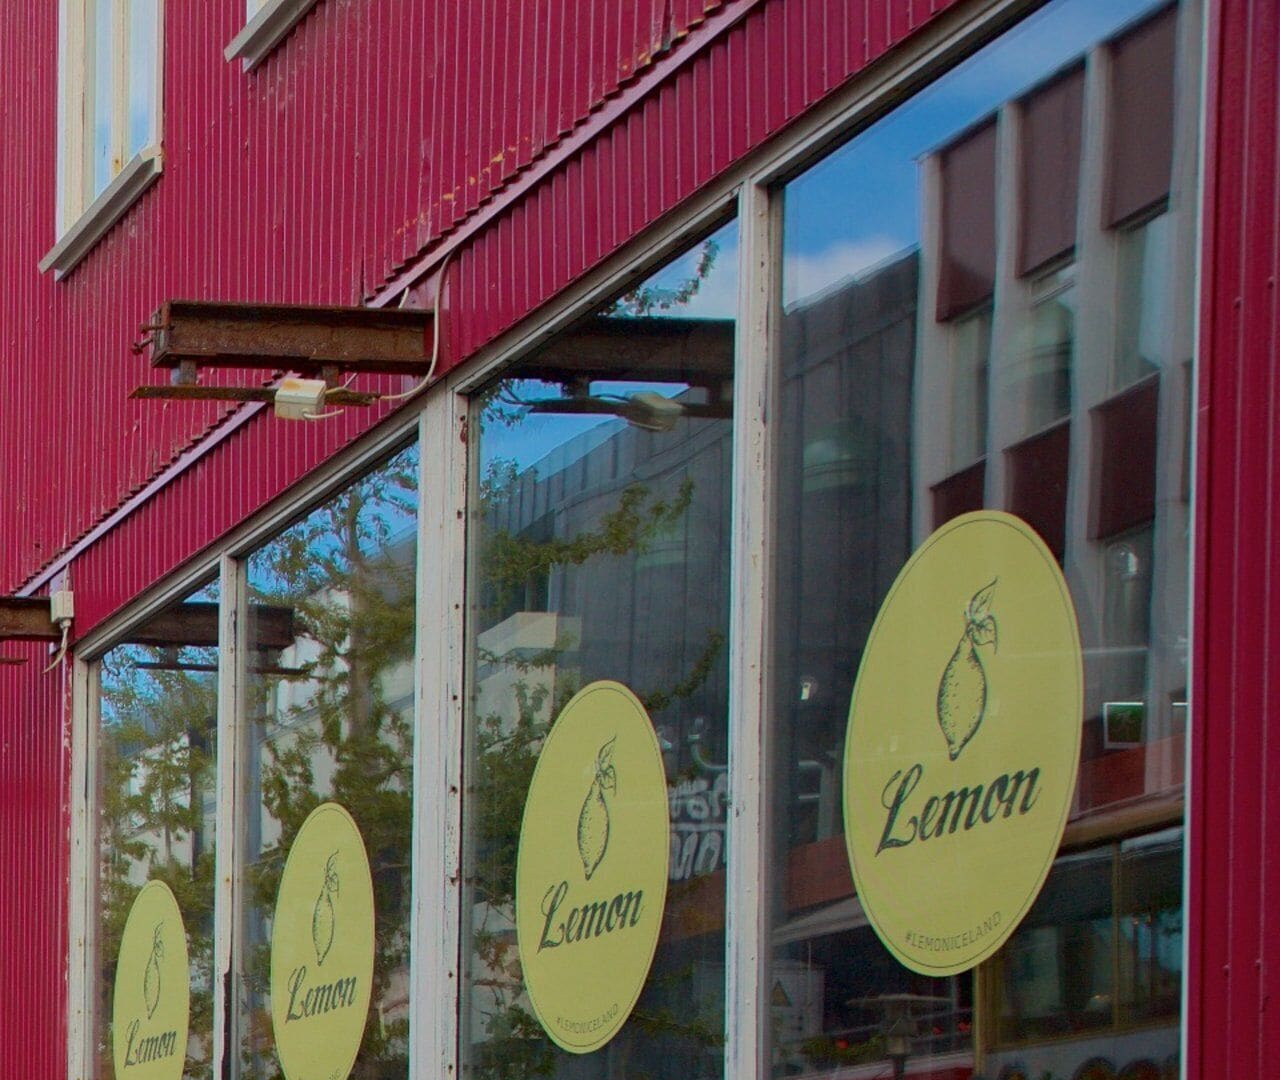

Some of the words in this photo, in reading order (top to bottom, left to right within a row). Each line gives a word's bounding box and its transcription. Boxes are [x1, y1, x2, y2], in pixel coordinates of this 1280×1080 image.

[874, 763, 1042, 858] Lemon
[537, 880, 645, 954] Lemon
[285, 965, 357, 1024] Lemon
[124, 1018, 177, 1069] Lemon
